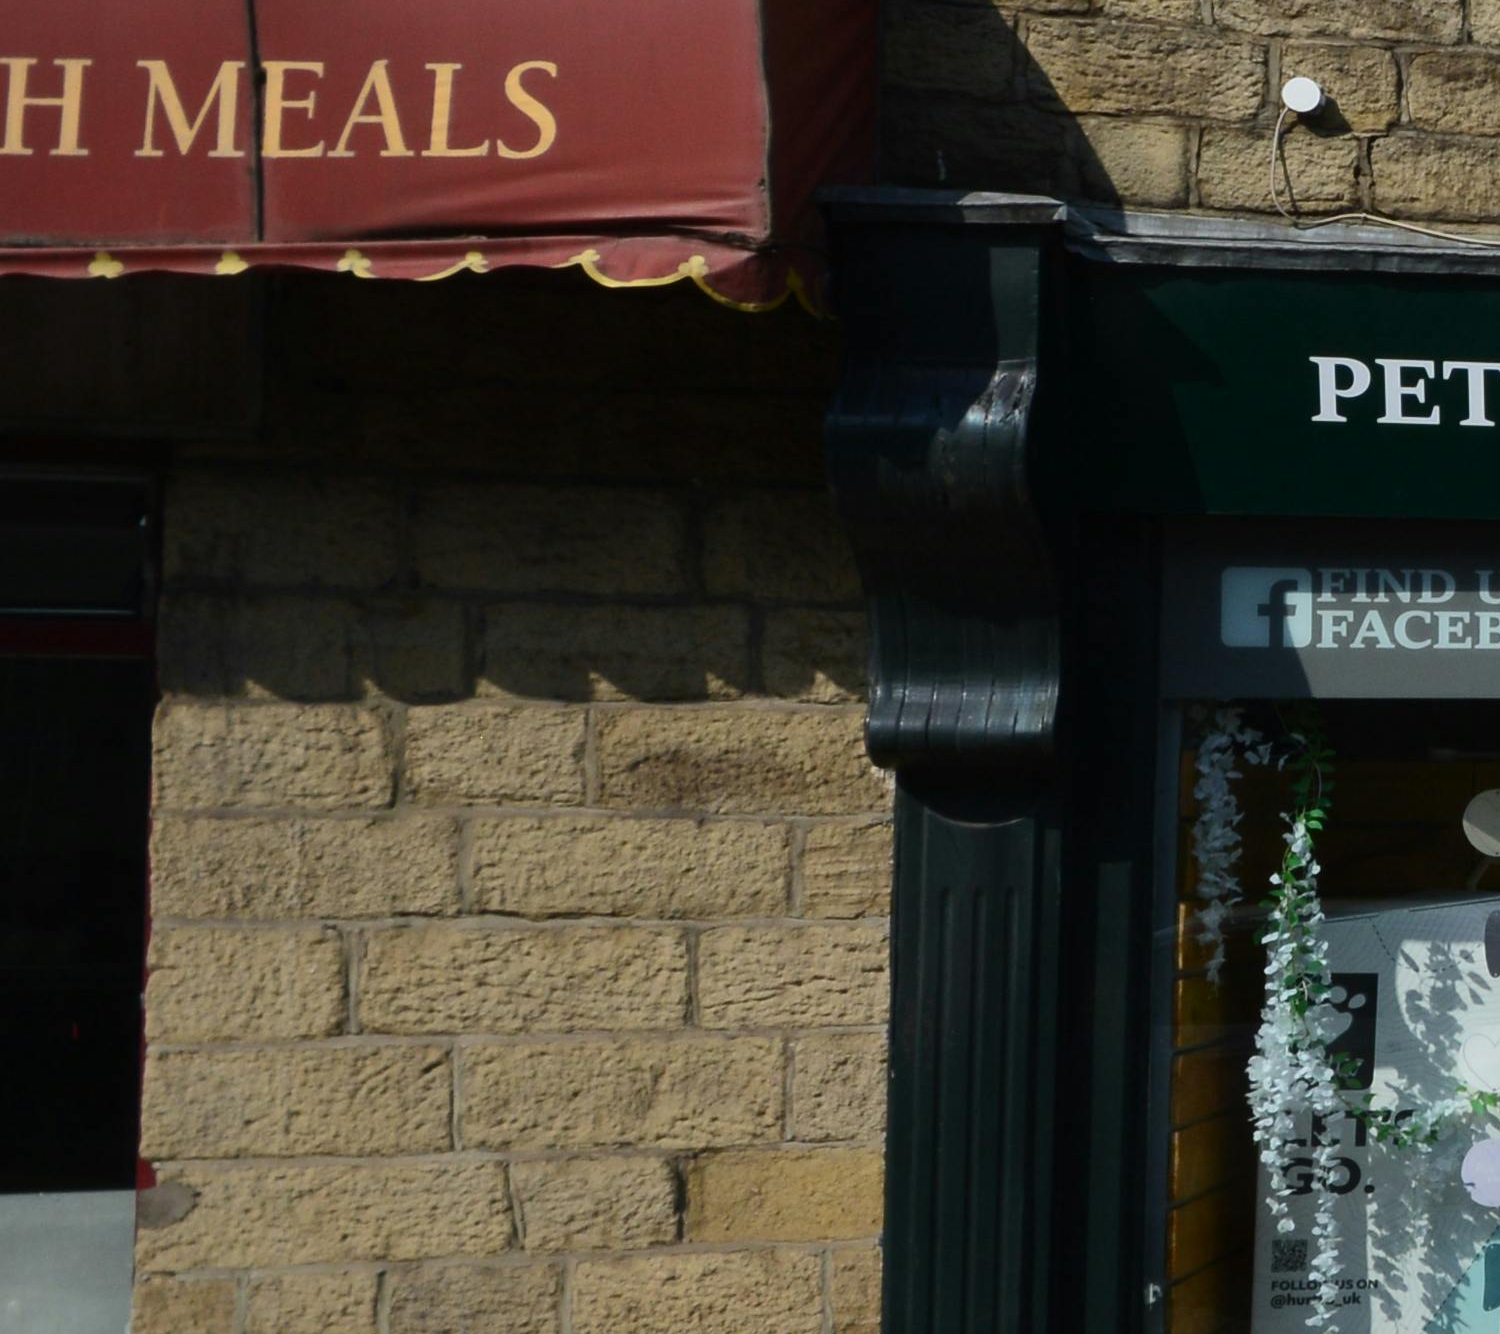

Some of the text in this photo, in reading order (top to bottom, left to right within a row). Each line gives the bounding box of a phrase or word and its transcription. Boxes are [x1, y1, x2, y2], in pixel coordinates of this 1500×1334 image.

[135, 59, 558, 159] MEALS
[1317, 569, 1455, 605] FIND
[1356, 1279, 1379, 1289] ON
